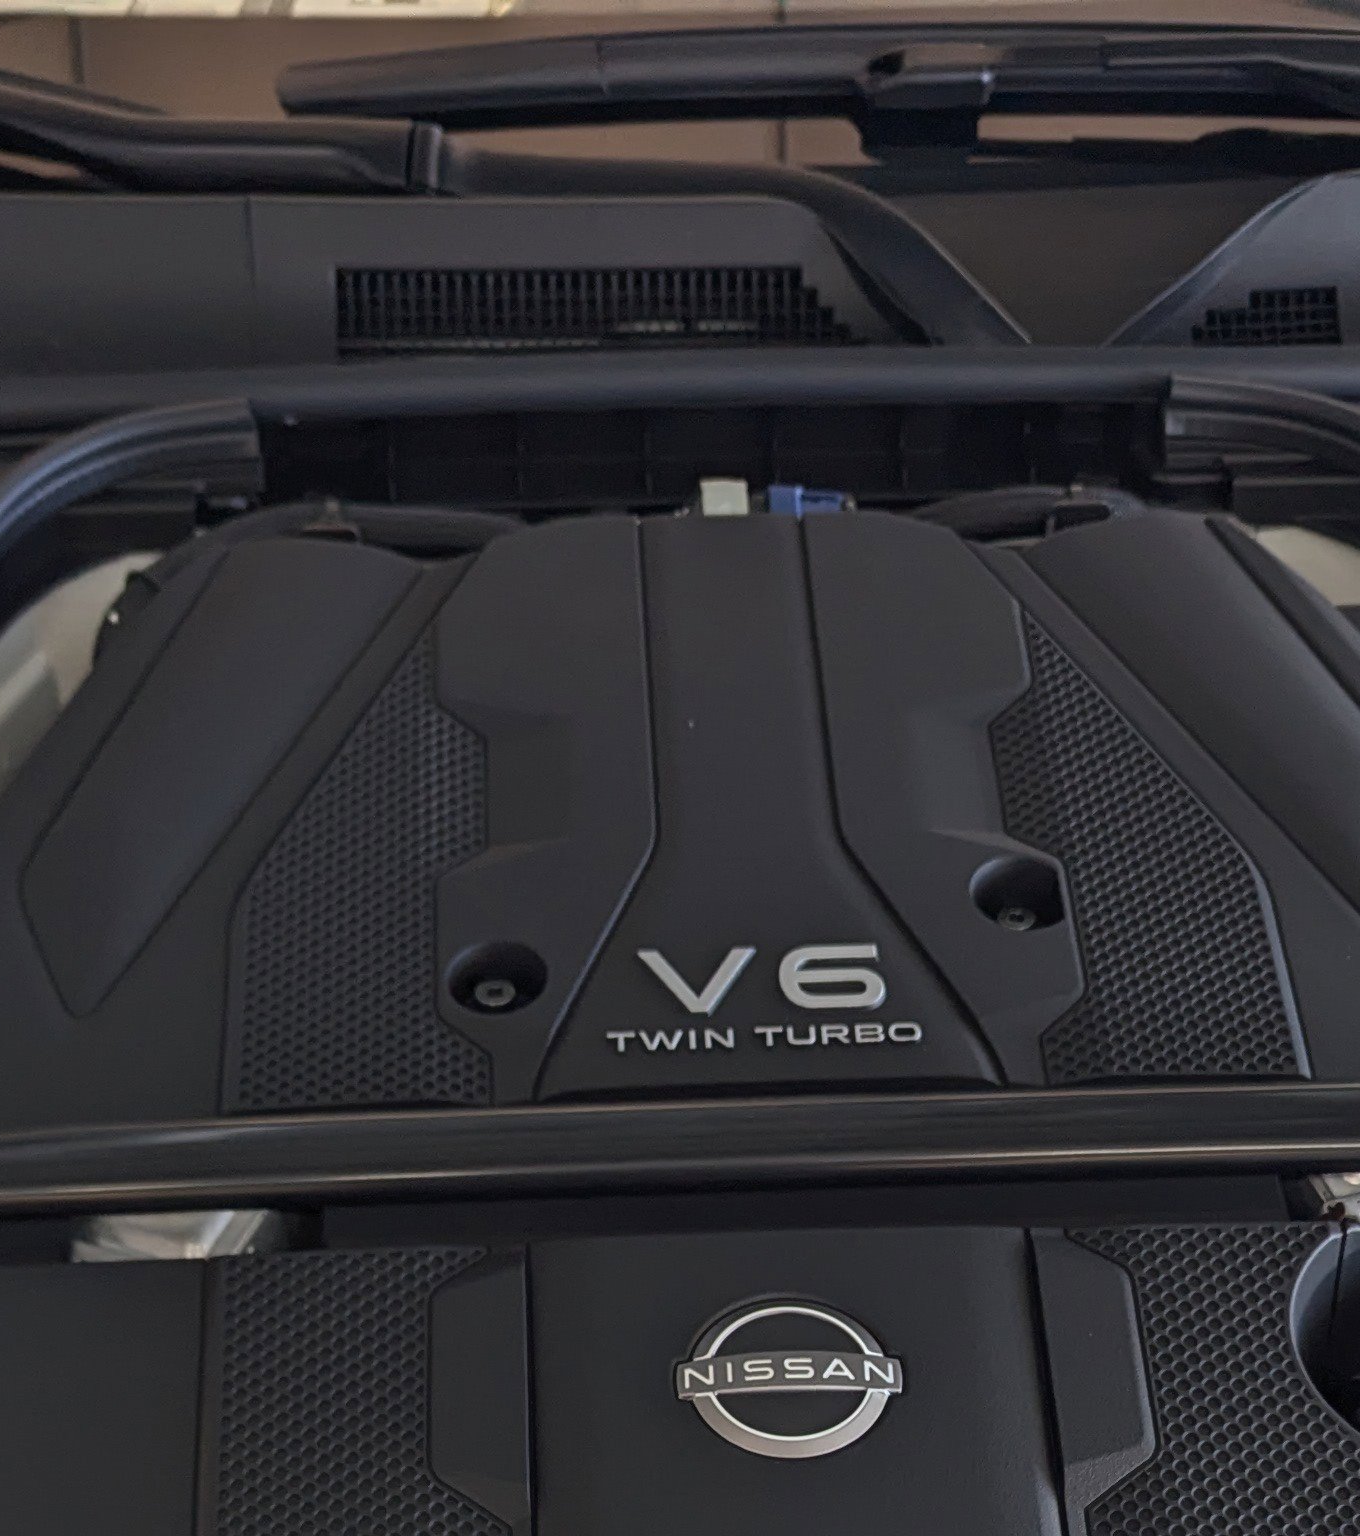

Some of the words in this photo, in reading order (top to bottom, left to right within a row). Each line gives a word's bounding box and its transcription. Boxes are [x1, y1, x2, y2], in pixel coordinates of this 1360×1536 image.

[637, 944, 886, 1017] V6
[606, 1027, 735, 1052] TWIN
[754, 1021, 923, 1047] TURBO
[684, 1358, 895, 1389] NISSAN
